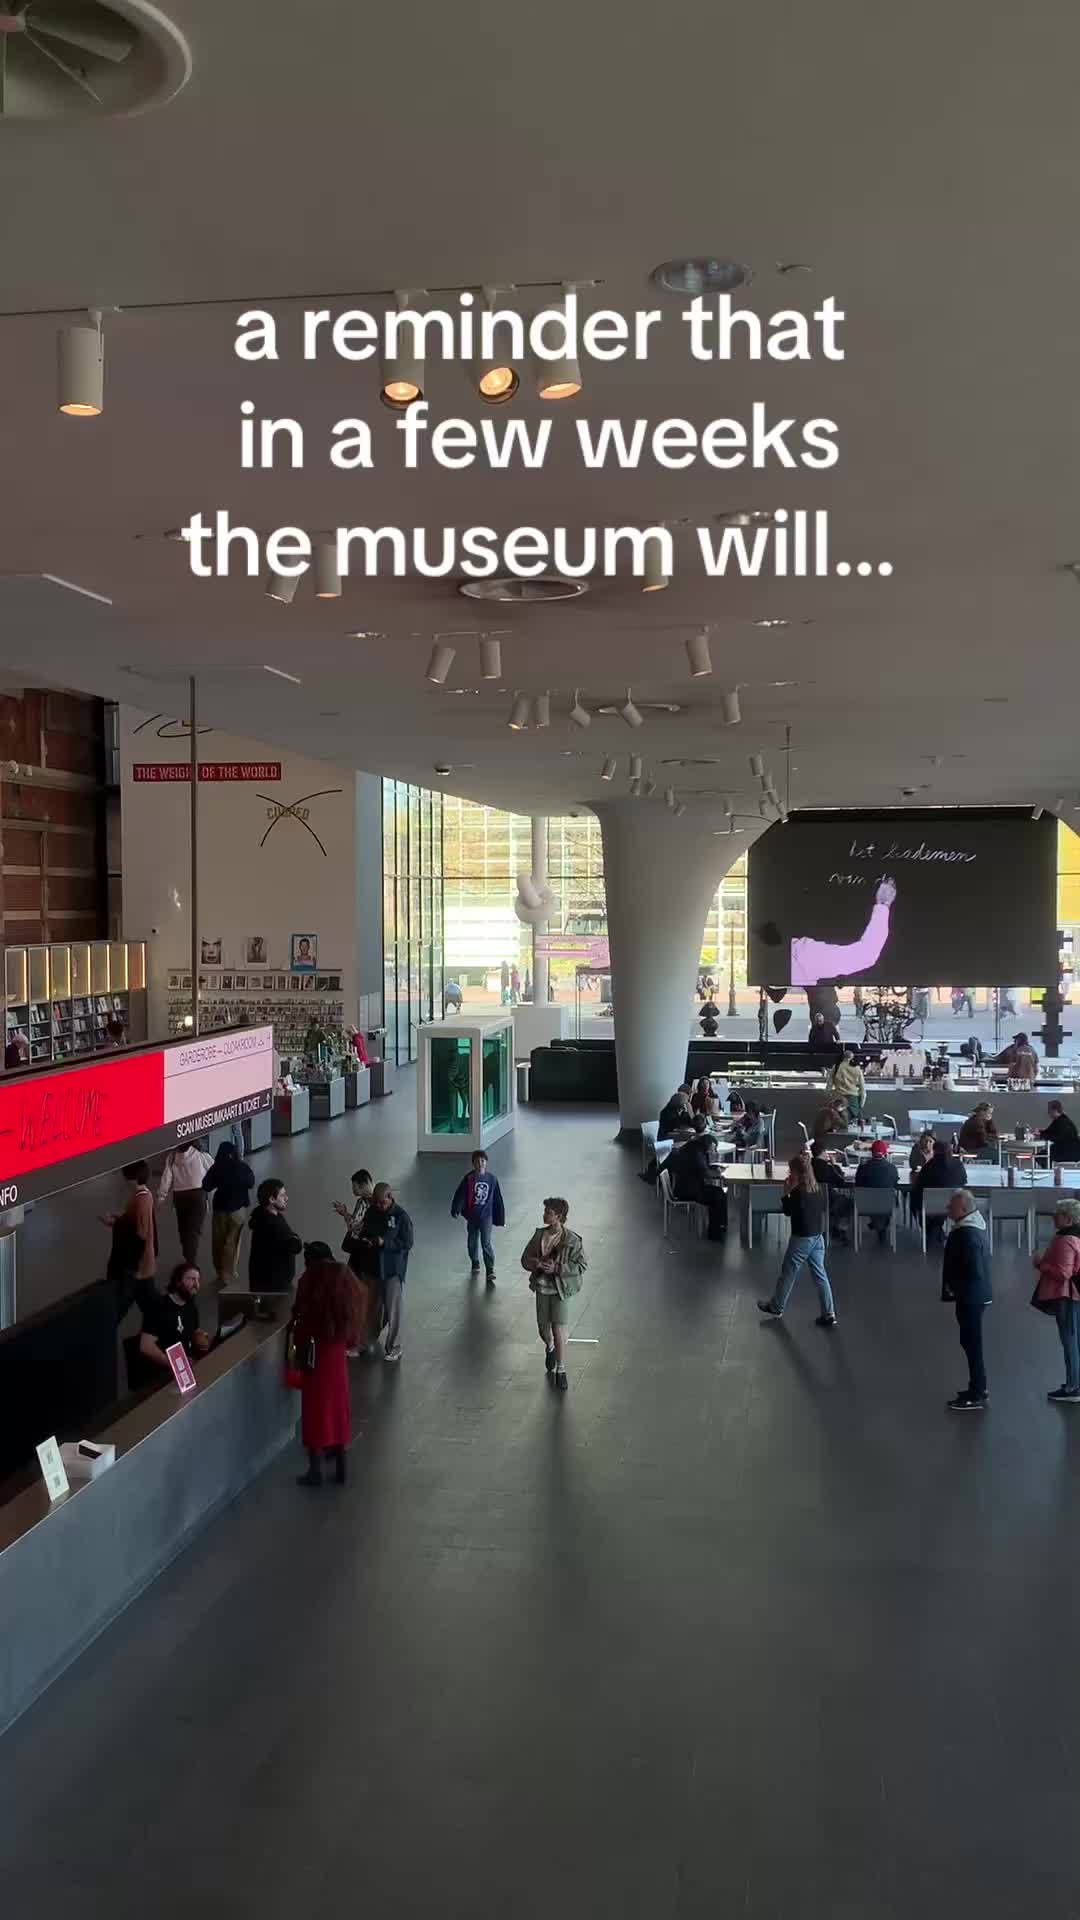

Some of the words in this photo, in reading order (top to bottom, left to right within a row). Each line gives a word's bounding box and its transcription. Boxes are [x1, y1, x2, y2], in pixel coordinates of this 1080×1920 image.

[136, 766, 156, 779] THE
[158, 766, 193, 779] WEIGH
[202, 766, 215, 778] OF
[219, 765, 238, 778] THE
[240, 765, 277, 778] WORLD
[176, 1119, 195, 1138] SCAN
[194, 1103, 239, 1131] MUSEUMKAART
[242, 1096, 261, 1114] TICKET
[0, 1184, 18, 1206] NFO
